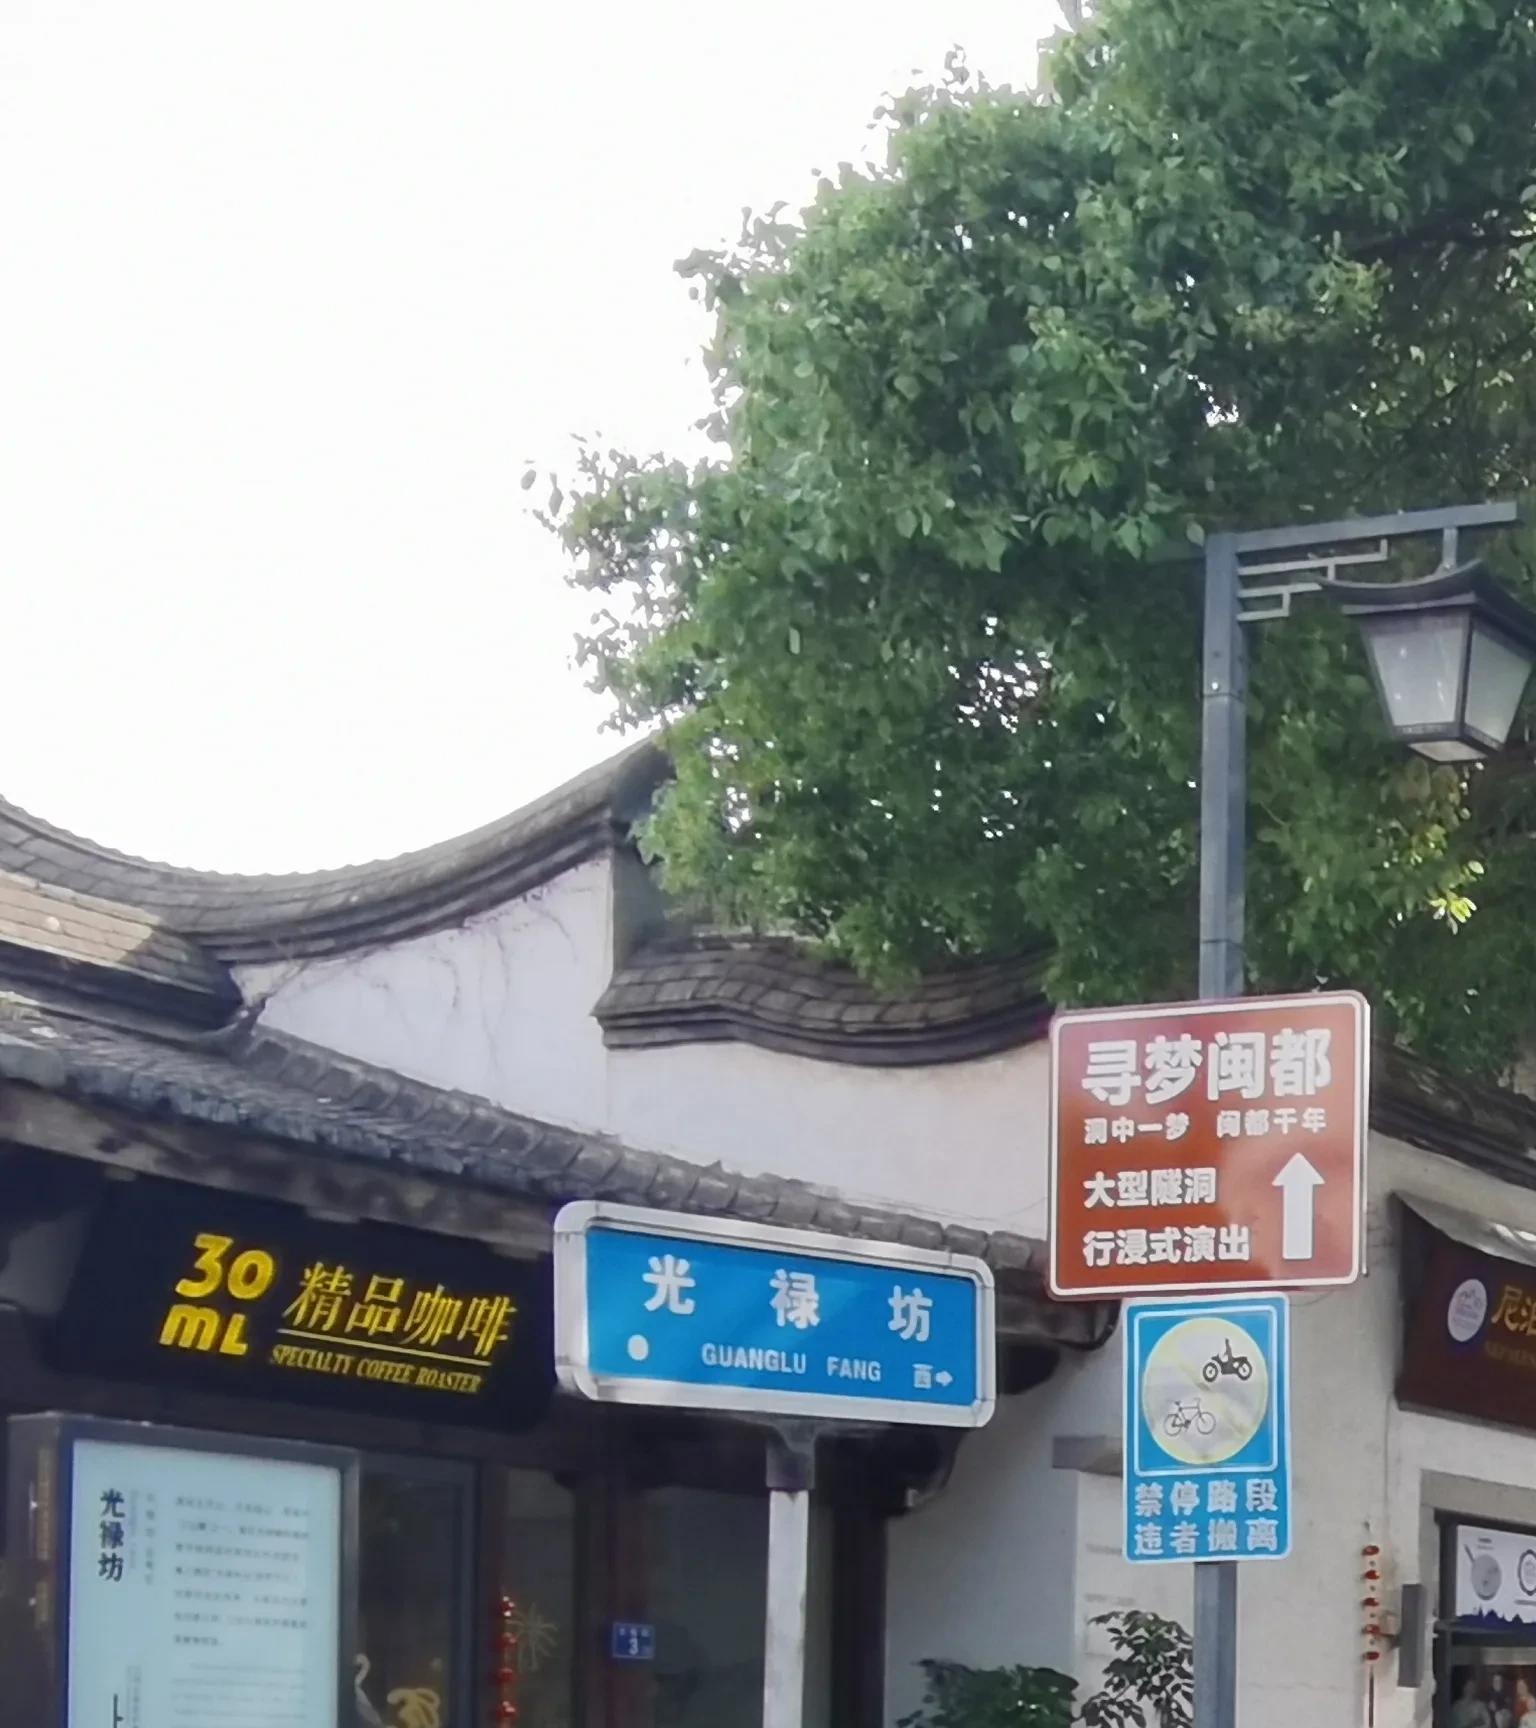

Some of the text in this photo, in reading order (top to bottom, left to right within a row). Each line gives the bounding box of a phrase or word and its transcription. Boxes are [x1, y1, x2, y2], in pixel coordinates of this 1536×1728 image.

[1082, 1028, 1332, 1106] 寻梦闽都
[1084, 1112, 1190, 1144] 洞中一梦
[1083, 1167, 1216, 1208] 大型隧洞
[175, 1232, 275, 1300] 30
[1082, 1223, 1250, 1267] 行浸式演出
[282, 1261, 518, 1357] 精品咖啡
[642, 1254, 933, 1343] 光禄坊
[270, 1344, 482, 1394] SPECIALTY COFFEE ROASTER
[702, 1343, 881, 1382] GUANGLU FANG
[1134, 1479, 1279, 1517] 禁停路段
[98, 1488, 125, 1583] 光禄坊
[1134, 1517, 1279, 1555] 违者搬离
